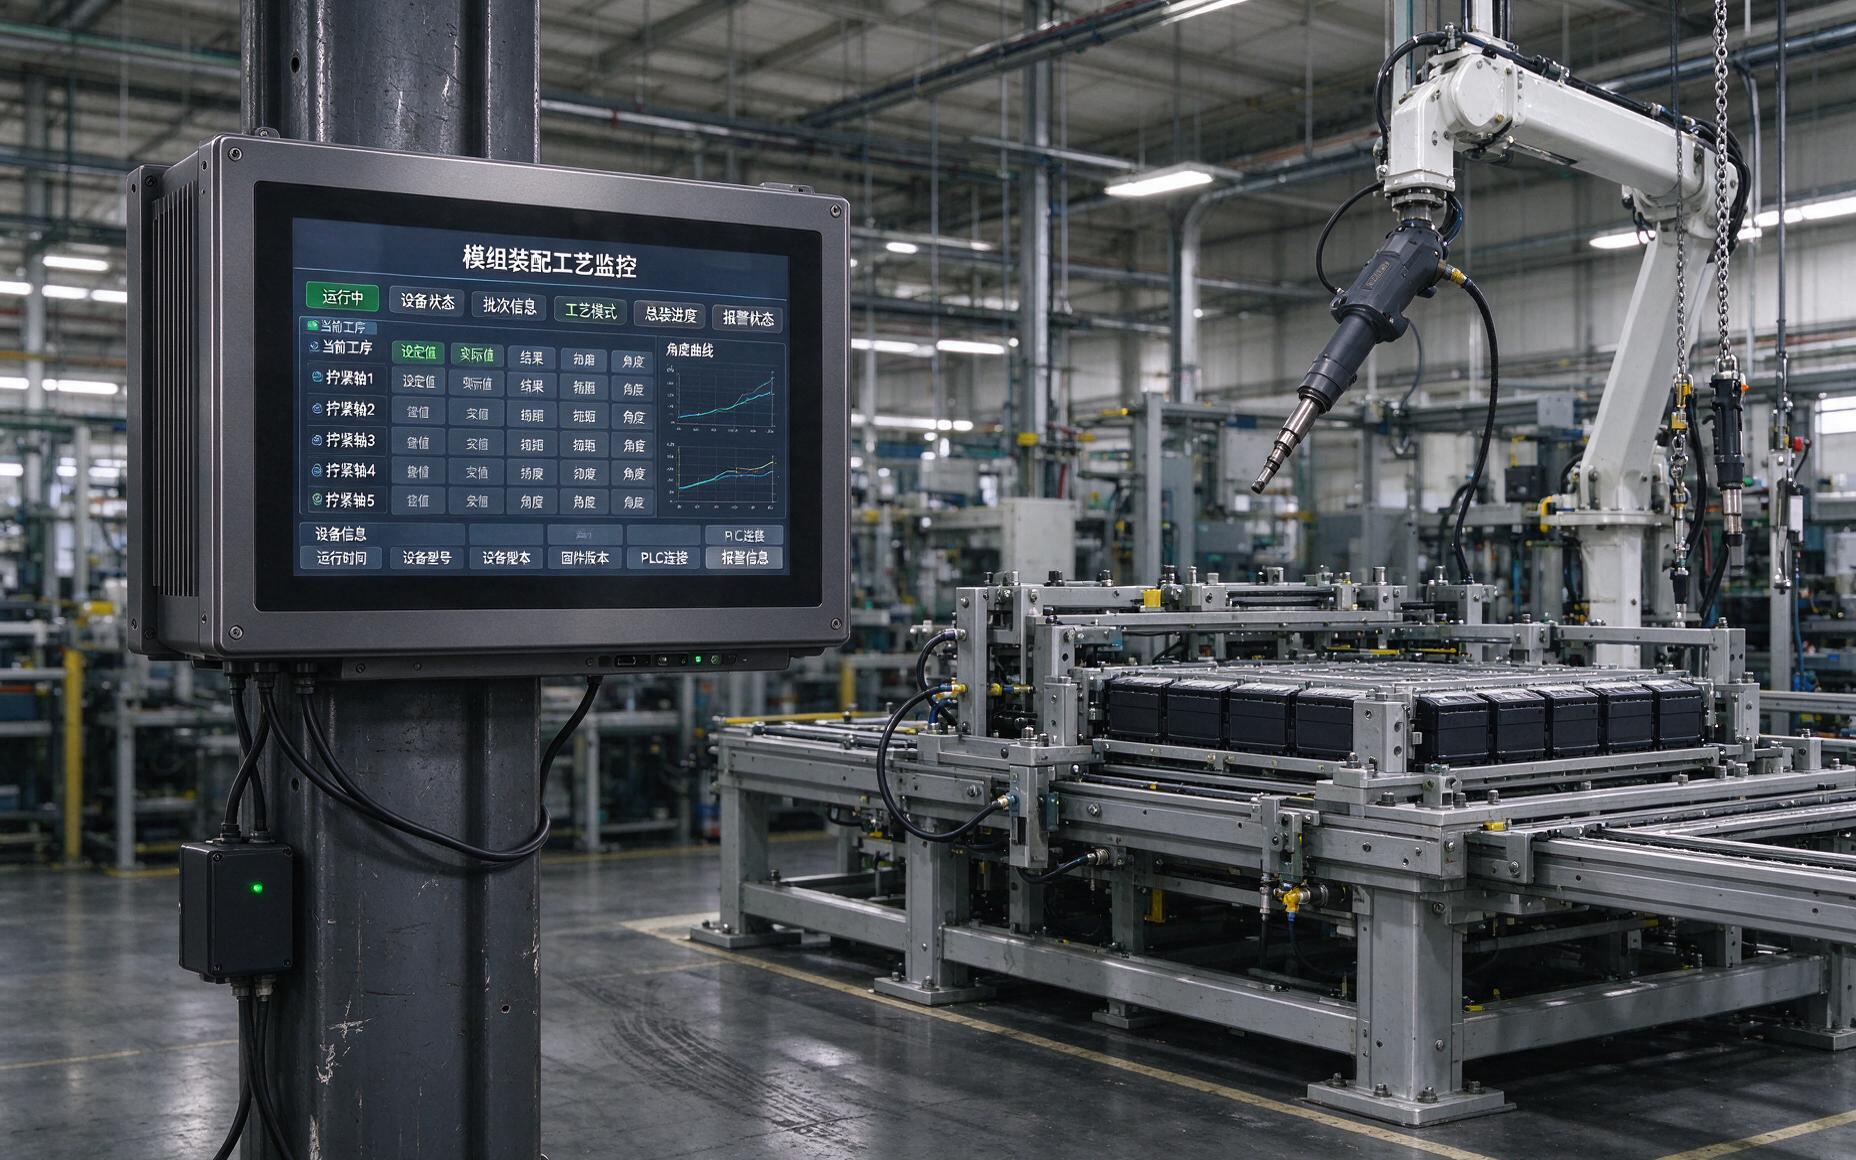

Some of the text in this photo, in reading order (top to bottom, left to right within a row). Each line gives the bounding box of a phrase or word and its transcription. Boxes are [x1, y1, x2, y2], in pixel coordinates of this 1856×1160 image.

[462, 244, 637, 278] 模组装配工艺监控
[322, 288, 364, 306] 运行中
[401, 292, 455, 310] 设备状态
[483, 296, 537, 315] 批次信息
[565, 303, 618, 320] 工艺模式
[323, 339, 373, 355] 当前工序
[401, 344, 437, 360] 设定值
[666, 342, 714, 358] 角度曲线
[520, 350, 544, 366] 结果
[326, 400, 375, 417] 拧紧轴2
[325, 432, 376, 448] 拧紧轴3
[325, 462, 376, 479] 拧紧轴4
[325, 491, 375, 508] 拧紧轴5
[315, 525, 367, 542] 设备信息
[317, 550, 367, 566] 运行时间
[722, 549, 769, 566] 报警信息
